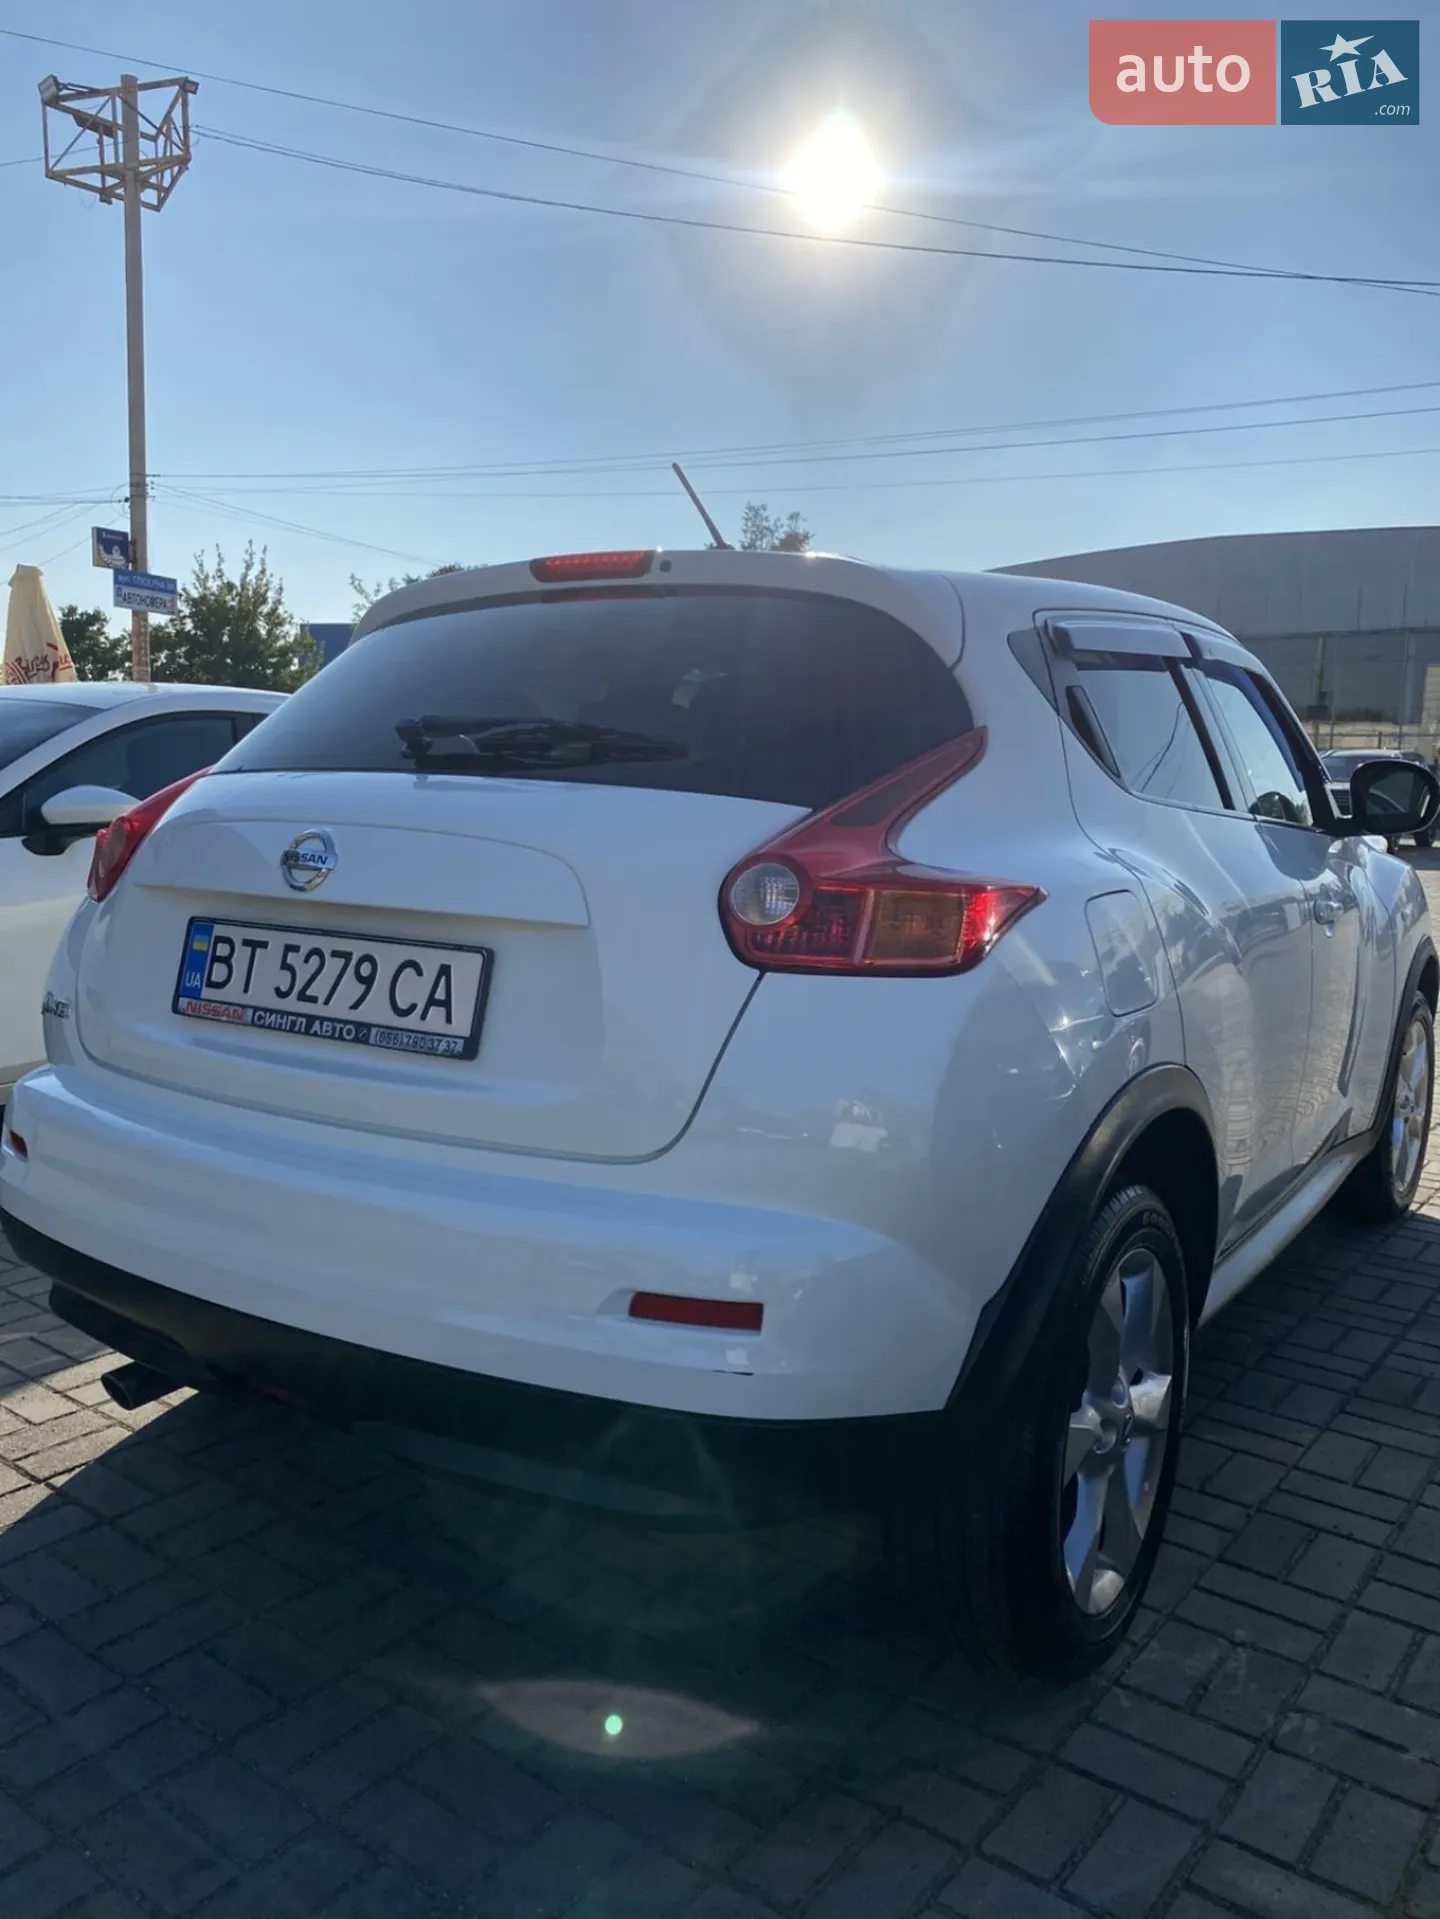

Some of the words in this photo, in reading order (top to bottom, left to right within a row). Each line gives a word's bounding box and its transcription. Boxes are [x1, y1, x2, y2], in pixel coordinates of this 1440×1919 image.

[184, 971, 202, 989] UA
[205, 935, 269, 995] BT
[274, 943, 379, 1011] 5279
[388, 959, 453, 1025] CA
[184, 1000, 244, 1021] NISSAN
[253, 1010, 307, 1032] СИНГЛ
[309, 1020, 356, 1040] АВТО
